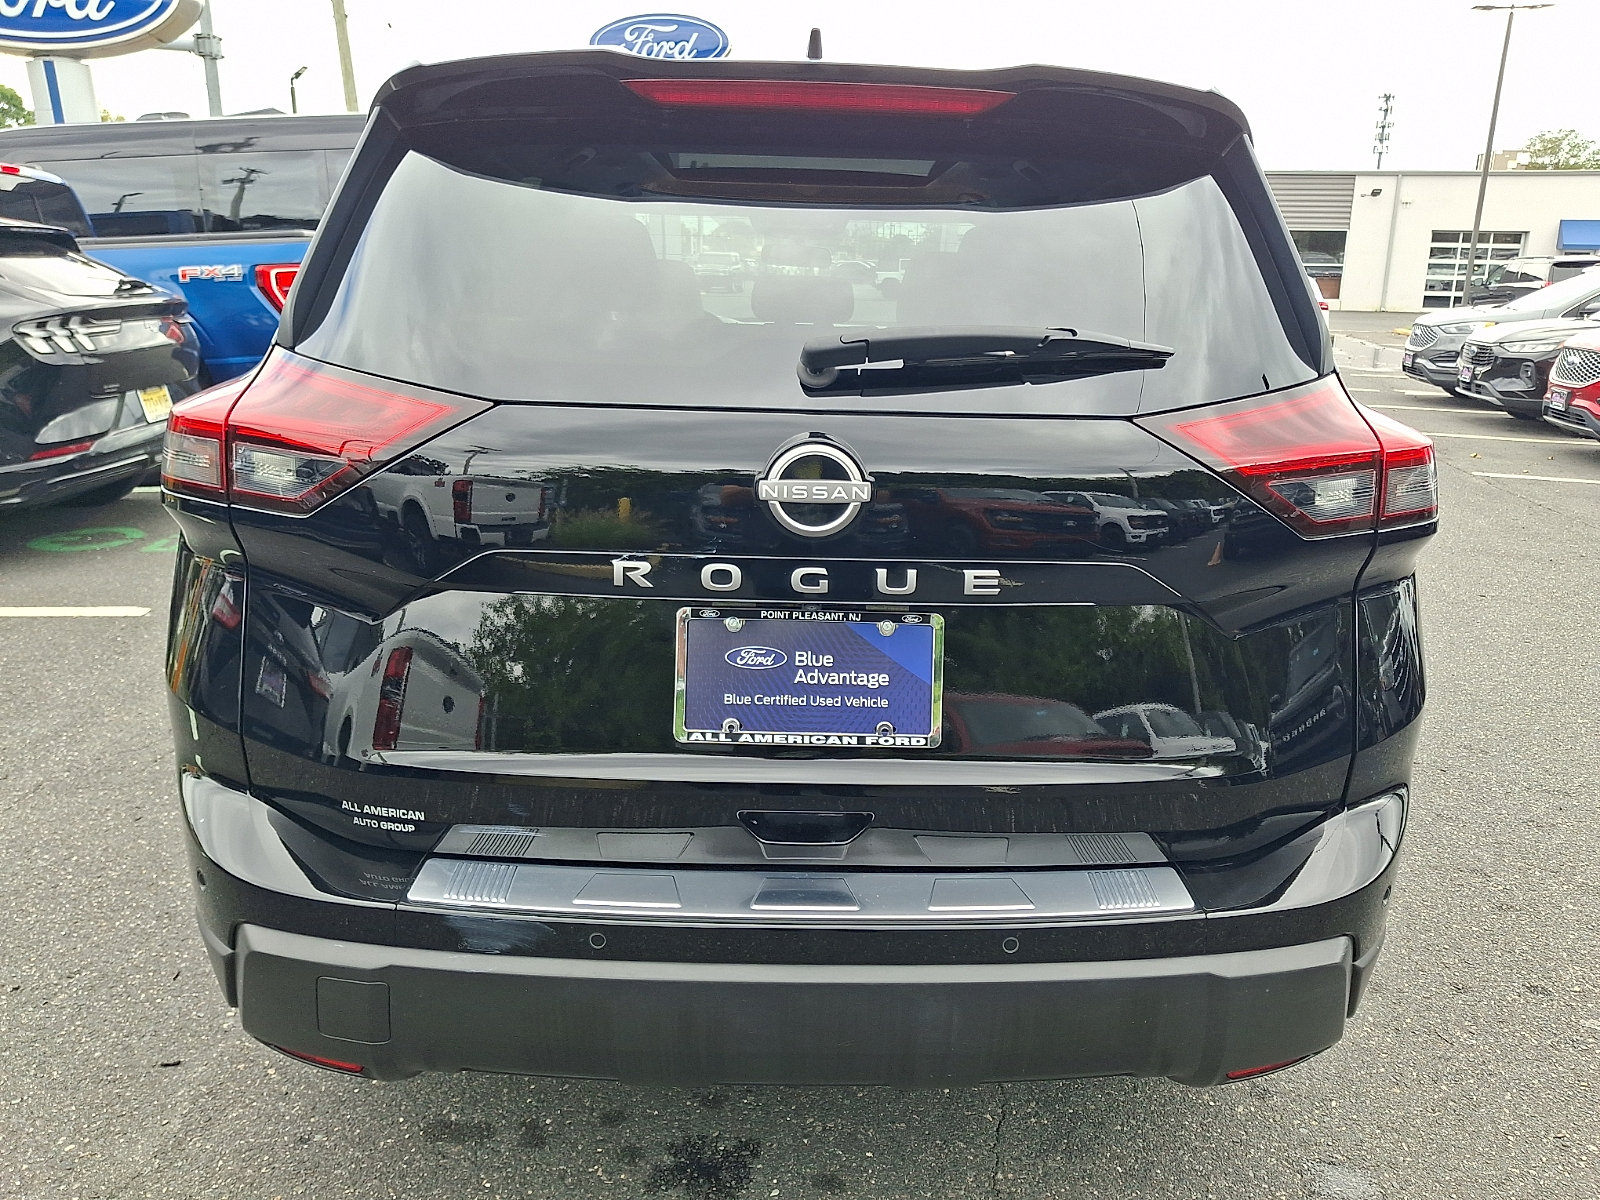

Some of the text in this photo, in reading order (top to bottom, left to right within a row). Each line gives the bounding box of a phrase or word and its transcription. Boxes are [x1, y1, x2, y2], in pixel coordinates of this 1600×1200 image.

[624, 24, 699, 58] Ford
[178, 264, 243, 283] FX4
[761, 484, 869, 501] NISSAN
[611, 559, 1002, 596] ROGUE
[760, 610, 862, 622] POINT PLEASANT, NJ
[736, 649, 775, 666] Ford
[794, 651, 834, 667] Blue
[793, 669, 890, 689] Advantage
[723, 693, 889, 708] Blue Certified Used Vehicle
[688, 732, 927, 746] ALL AMERICAN FORD
[341, 800, 424, 820] ALL AMERICAN
[353, 816, 415, 833] AUTO GROUP
